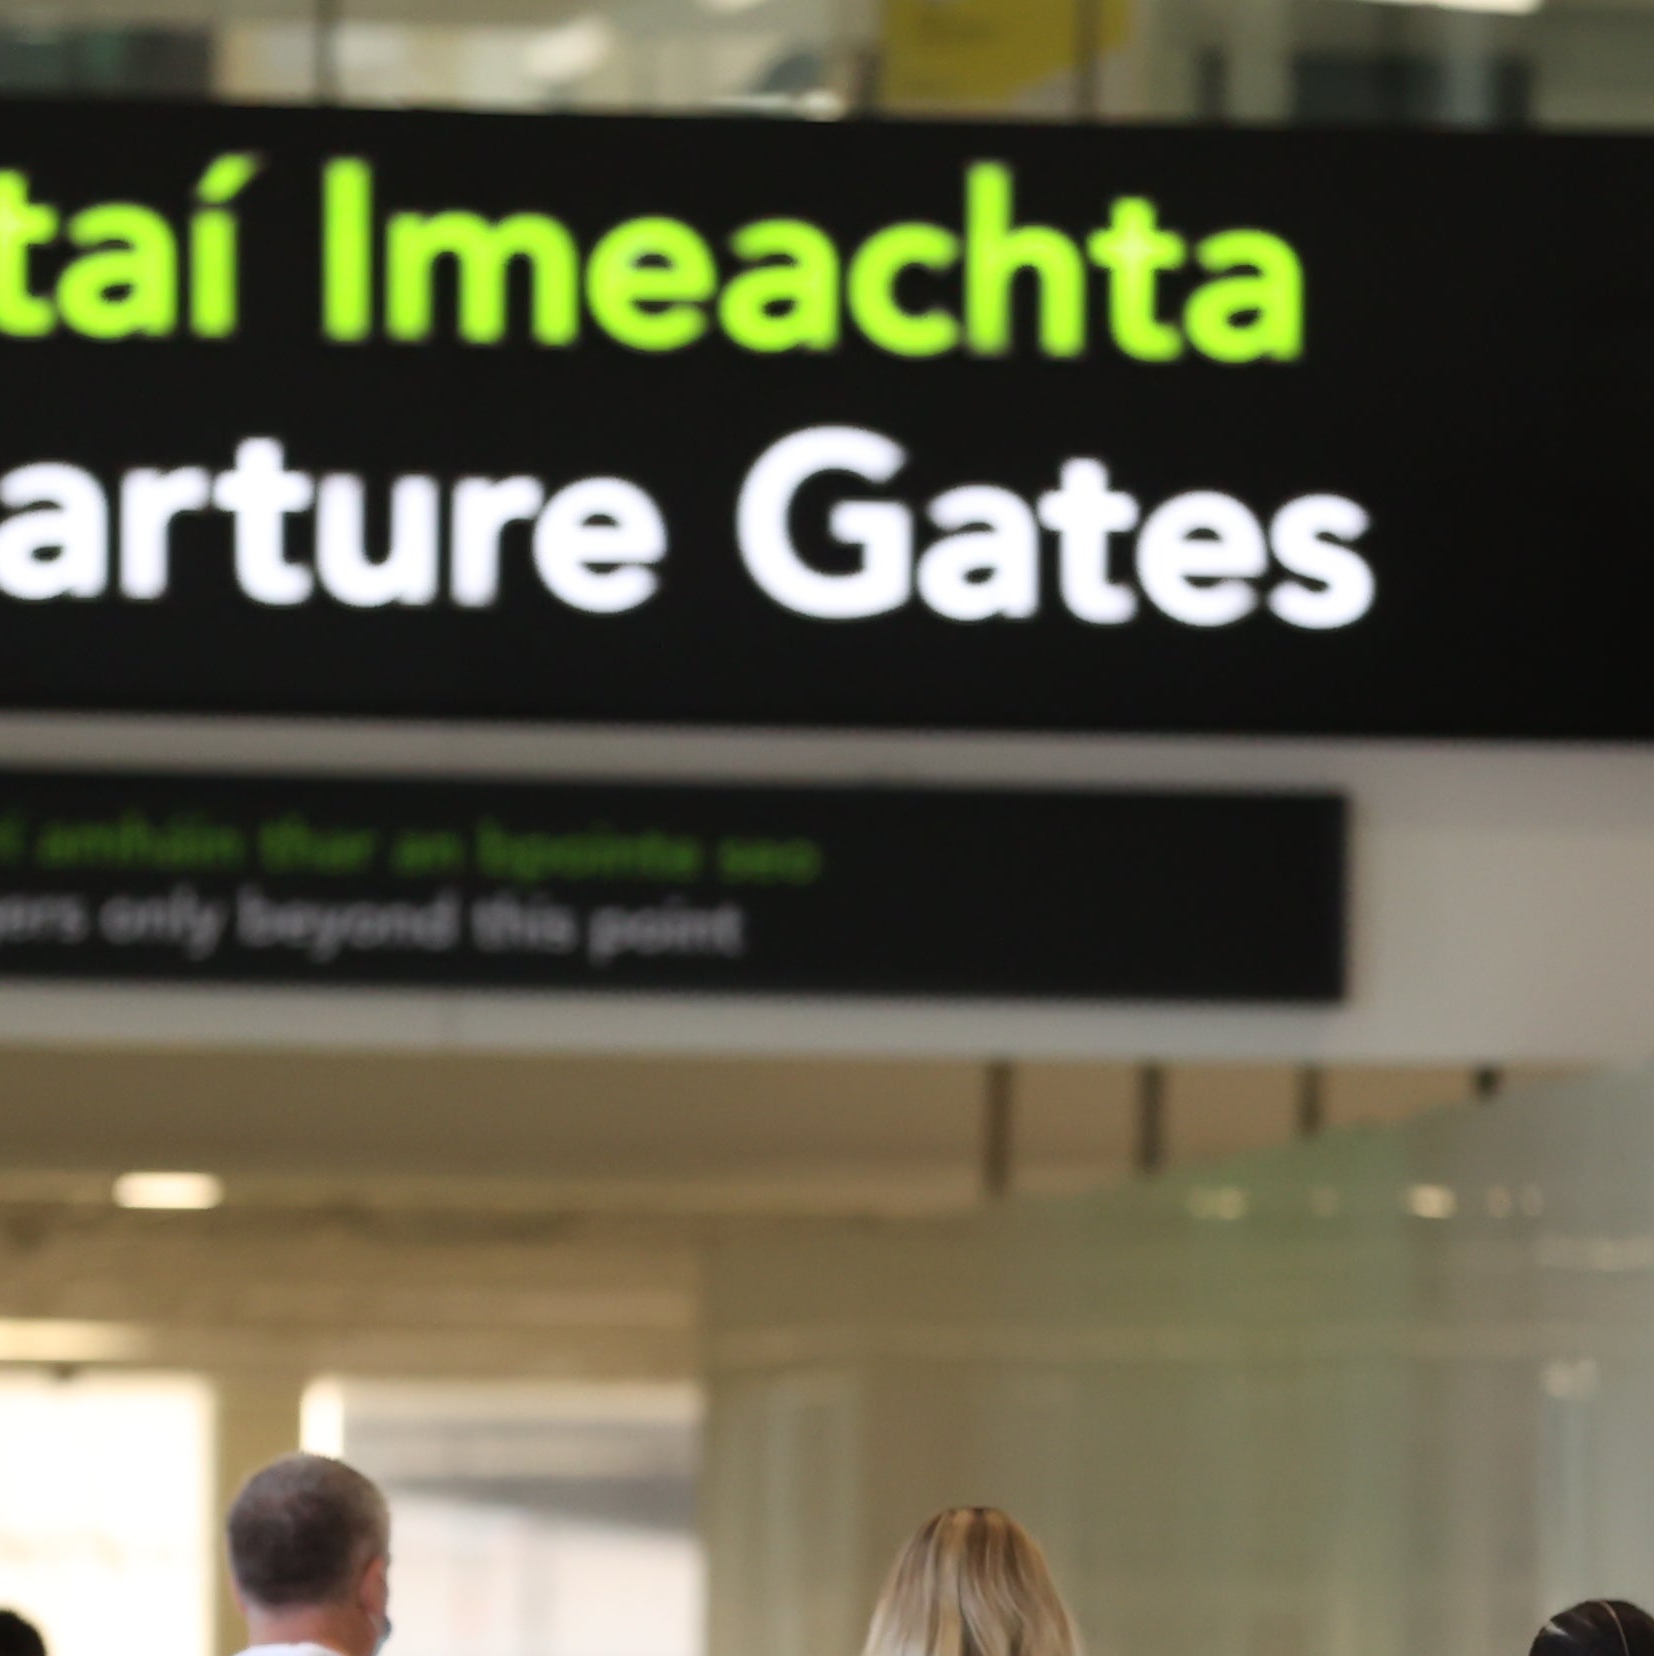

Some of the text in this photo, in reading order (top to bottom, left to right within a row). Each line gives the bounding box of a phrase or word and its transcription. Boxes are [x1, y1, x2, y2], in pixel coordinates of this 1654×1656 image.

[322, 157, 1305, 363] Imeachta
[735, 424, 1376, 631] Gates
[100, 884, 221, 958] only
[237, 884, 459, 960] beyond
[471, 887, 576, 955] this
[588, 894, 742, 968] point
